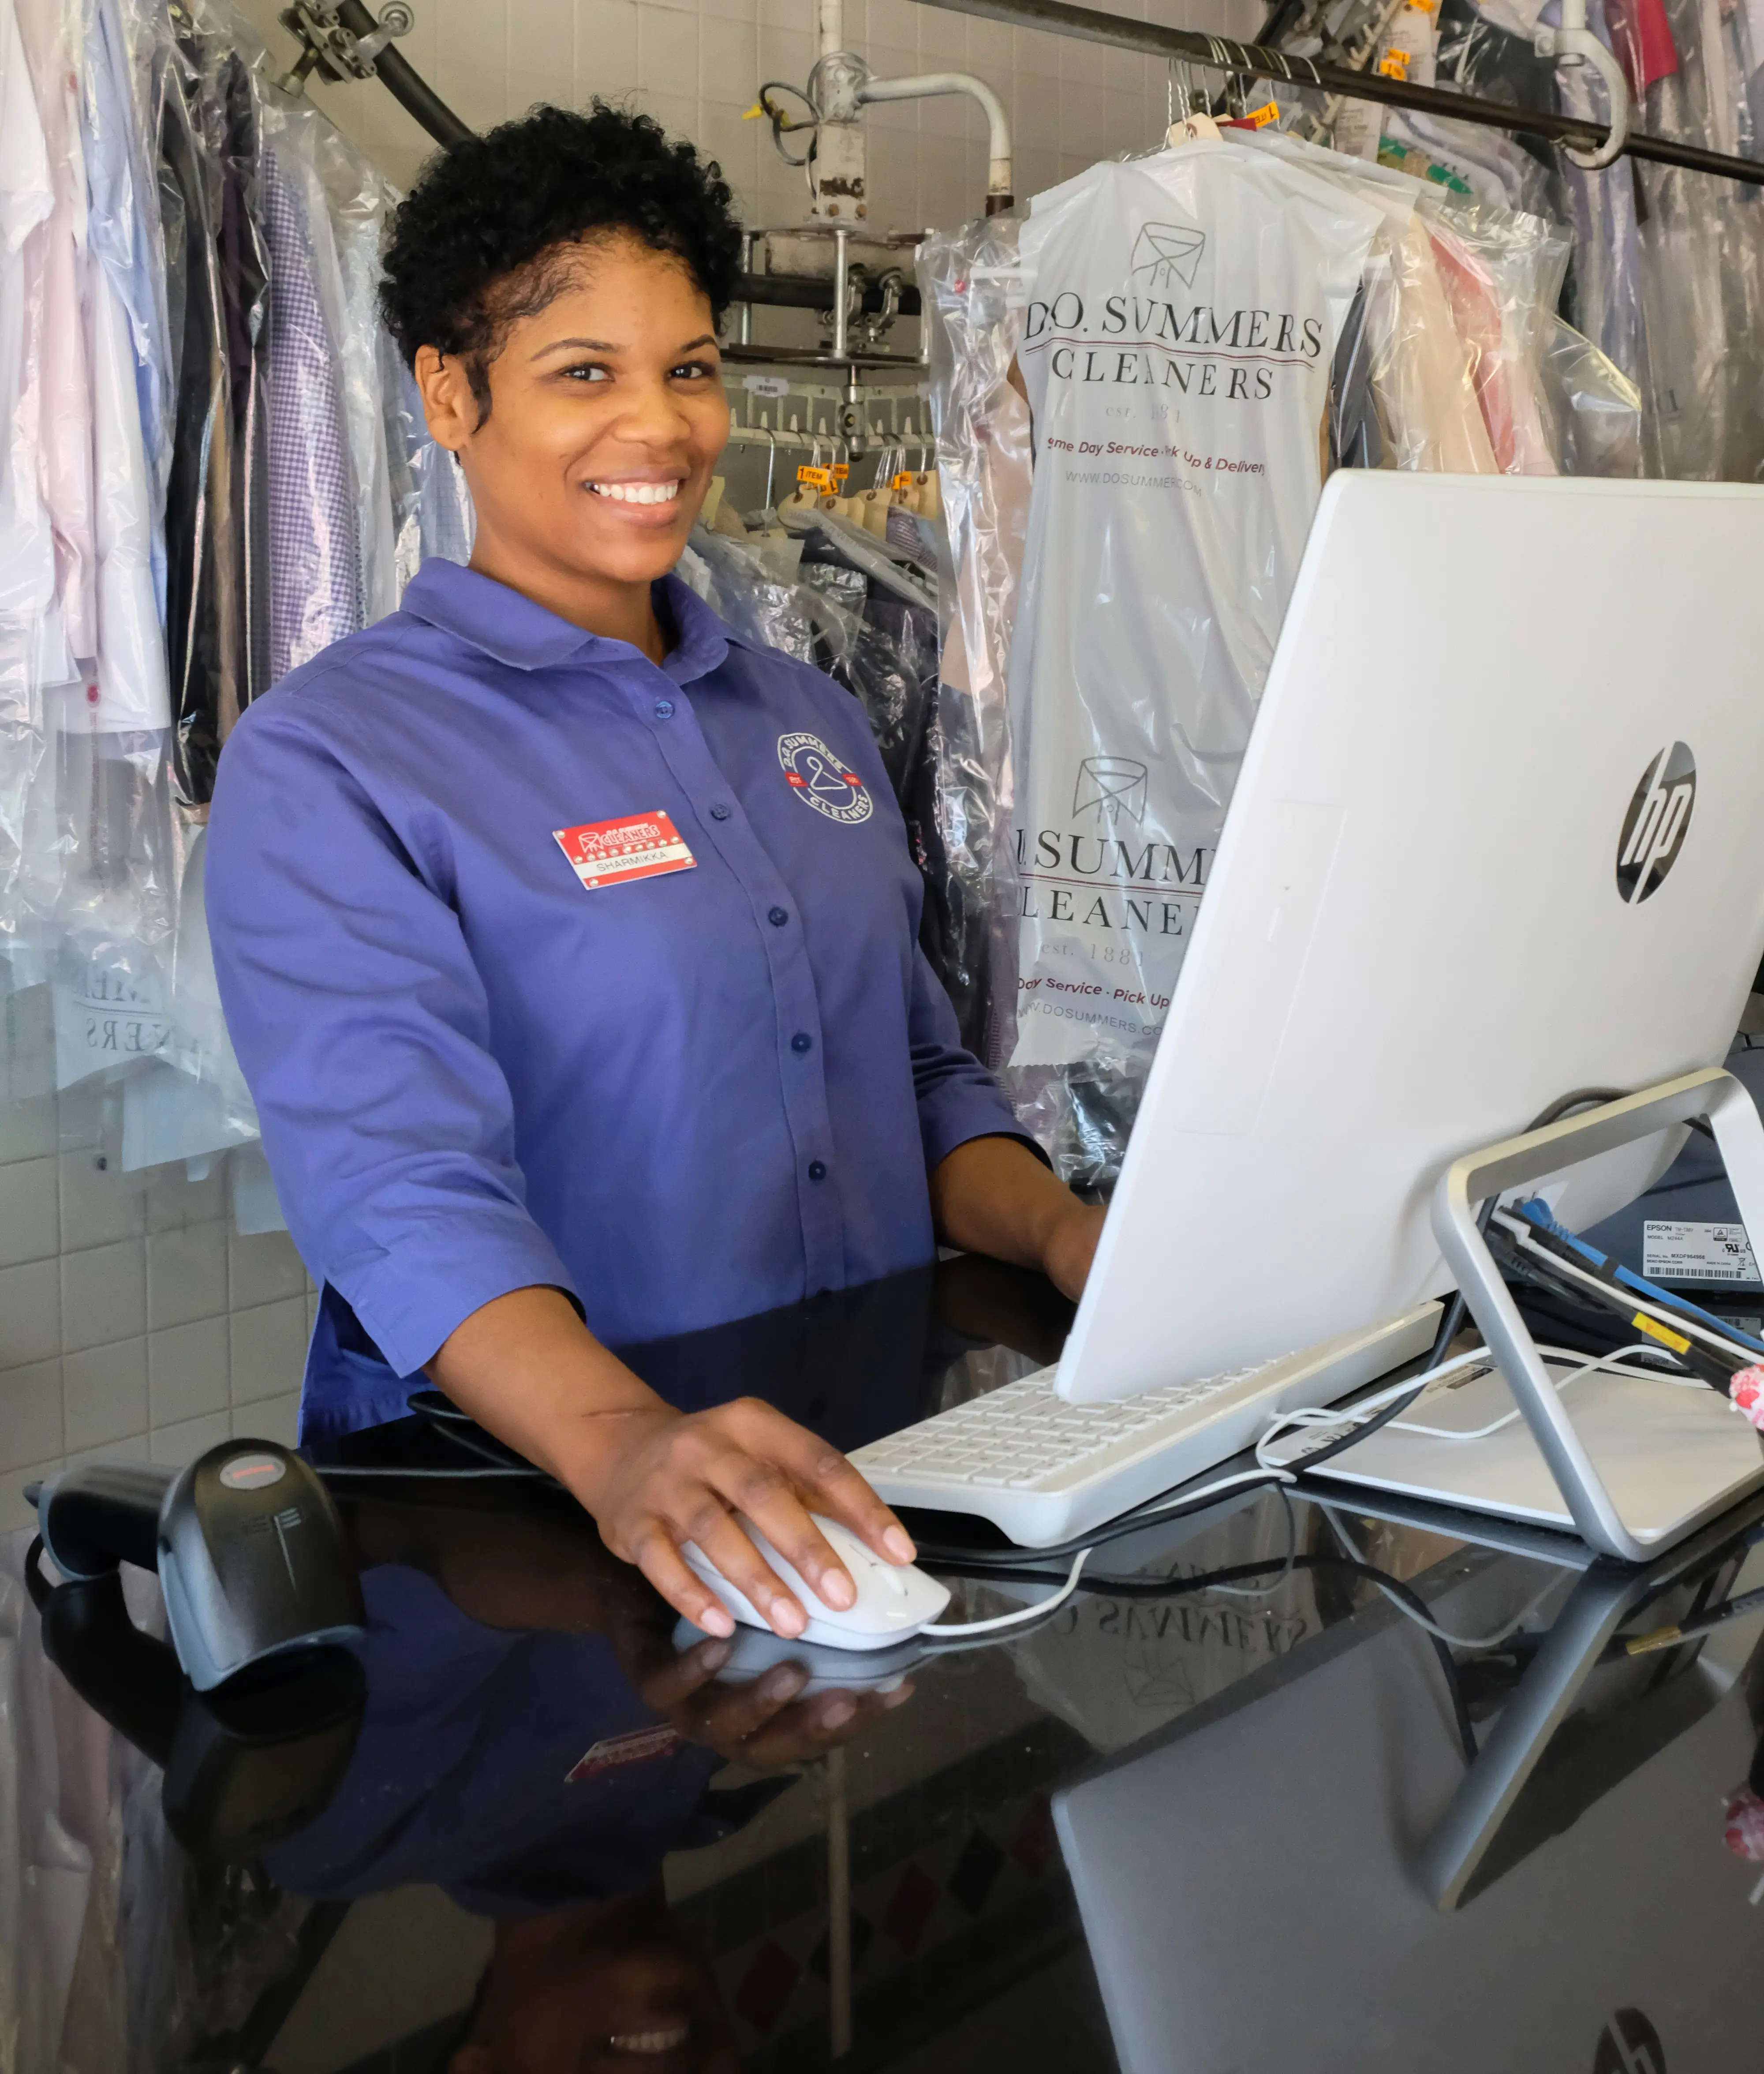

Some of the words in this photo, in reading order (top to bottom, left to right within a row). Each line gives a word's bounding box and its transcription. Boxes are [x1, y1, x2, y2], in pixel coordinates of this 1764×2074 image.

[1255, 112, 1267, 124] ITE
[1024, 292, 1088, 340] D.O.
[1102, 296, 1323, 358] SUMMERS
[1052, 348, 1273, 400] CLEANERS
[1078, 441, 1104, 456] Day
[1106, 441, 1159, 457] Service
[1184, 451, 1202, 467] Up
[1204, 457, 1213, 469] &
[800, 467, 804, 479] 1
[805, 471, 823, 480] ITEM
[810, 794, 869, 820] CLEANERS
[601, 824, 661, 846] CLEANERS
[1618, 741, 1694, 904] hp
[596, 852, 669, 872] SHARMIKKA
[1035, 830, 1216, 885] SUMM
[1041, 944, 1074, 956] est.
[1046, 978, 1102, 995] Service
[1114, 988, 1146, 1005] Pick
[1150, 993, 1170, 1009] Up
